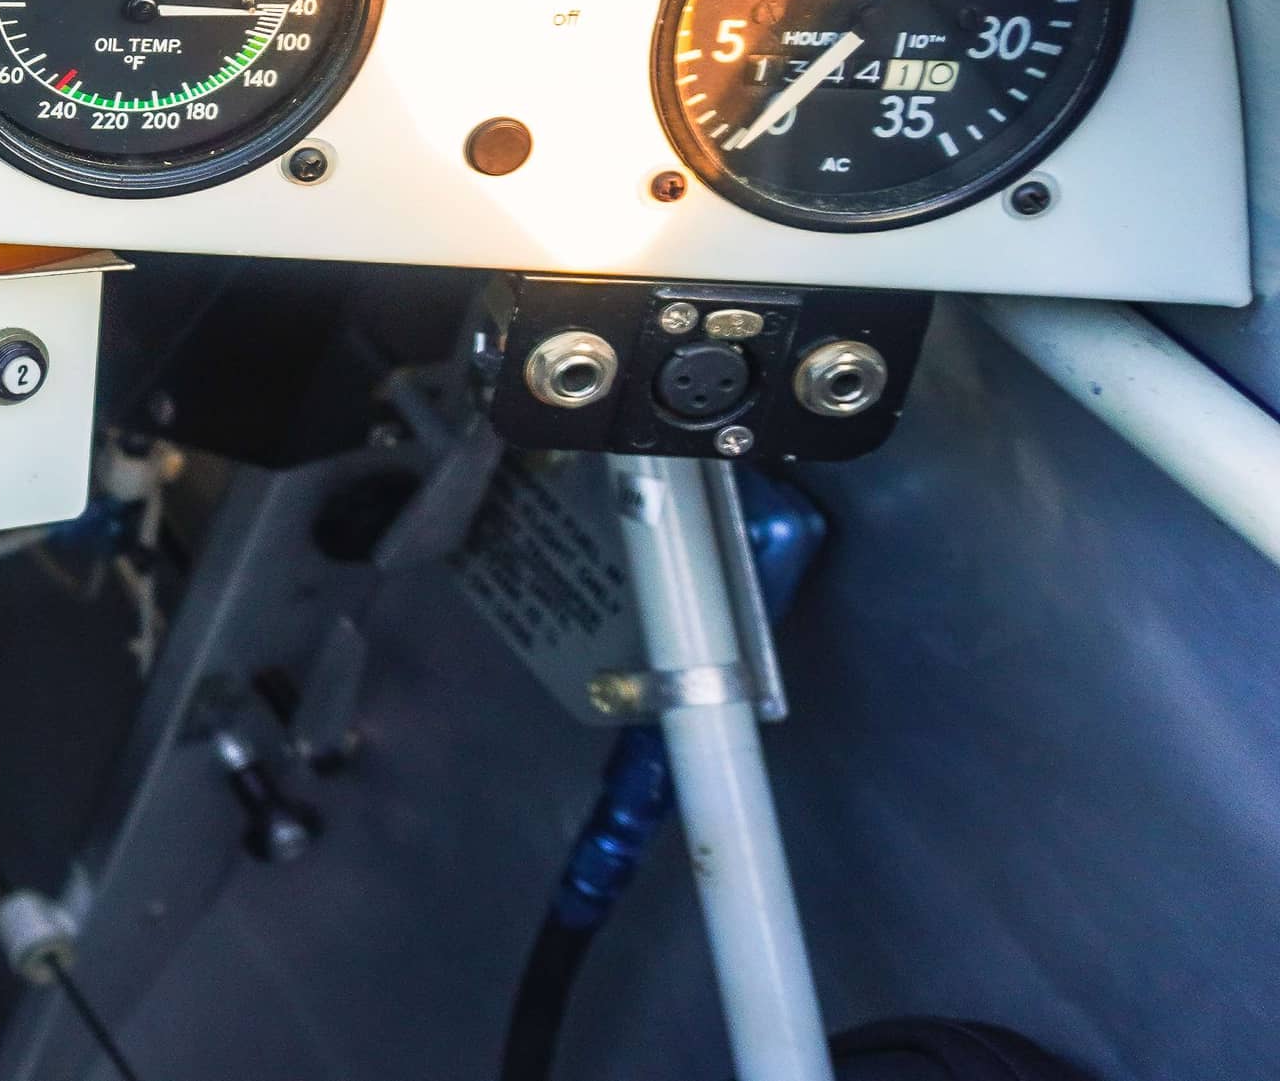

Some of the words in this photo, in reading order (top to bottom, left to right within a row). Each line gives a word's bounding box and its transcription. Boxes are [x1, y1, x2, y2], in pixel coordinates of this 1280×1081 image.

[288, 0, 317, 16] 40
[553, 10, 581, 26] off
[95, 38, 125, 53] OIL
[129, 38, 182, 54] TEMP.
[276, 34, 310, 51] 100
[712, 19, 747, 62] 5
[968, 15, 1032, 60] 30
[243, 70, 277, 87] 140
[38, 102, 77, 119] 240
[186, 103, 218, 120] 180
[873, 95, 936, 139] 35
[91, 113, 129, 129] 220
[142, 113, 180, 129] 200
[821, 157, 851, 172] AC
[17, 365, 30, 386] 2
